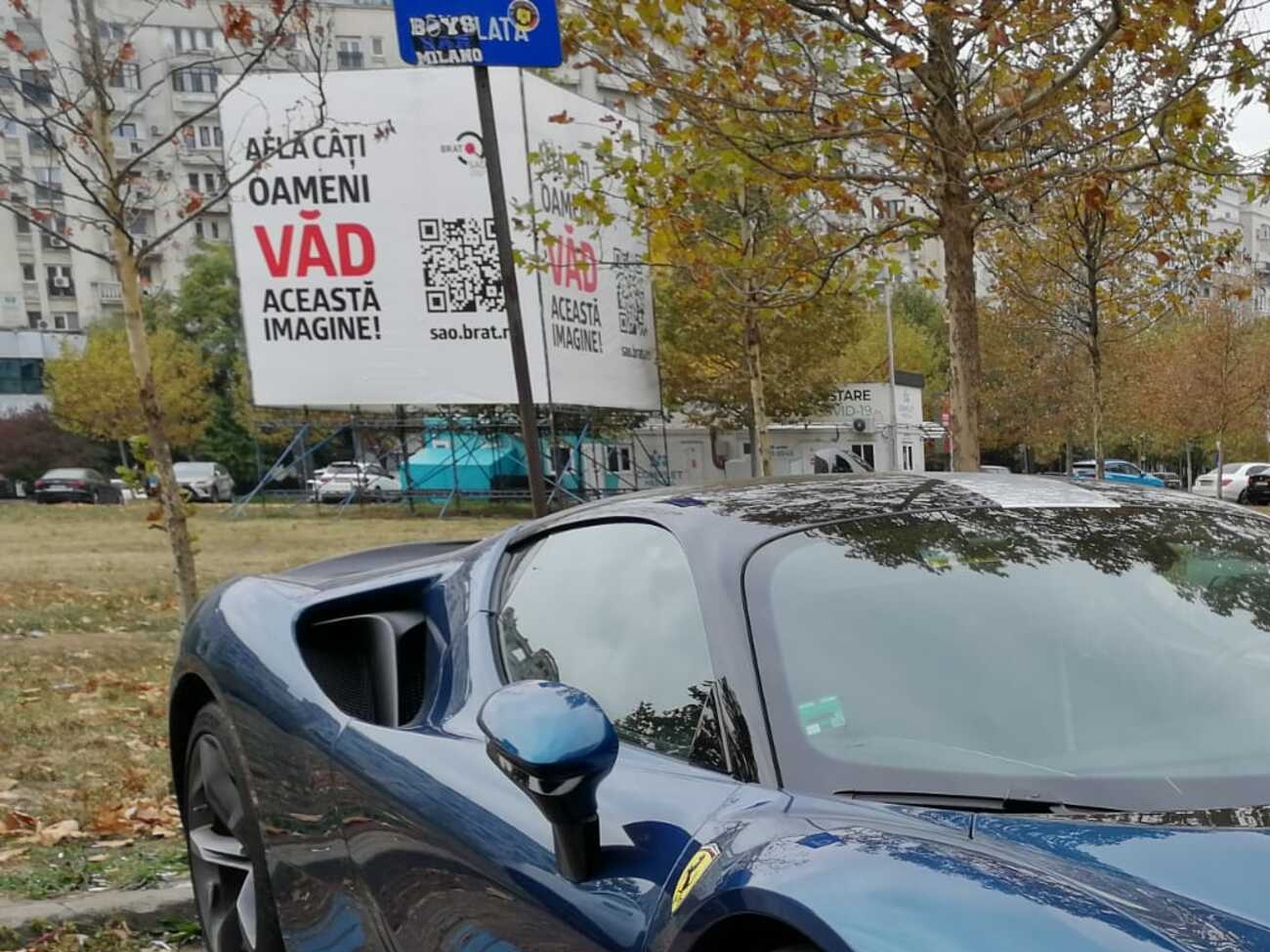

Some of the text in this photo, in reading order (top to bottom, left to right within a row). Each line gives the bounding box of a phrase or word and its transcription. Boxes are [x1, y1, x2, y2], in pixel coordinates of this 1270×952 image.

[474, 16, 529, 42] LATA
[416, 47, 483, 66] MILANO
[248, 174, 371, 206] OAMENI
[253, 209, 376, 277] VĂD
[547, 223, 598, 293] VĂD
[263, 281, 381, 313] ACEASTĂ
[551, 294, 602, 327] ACEASTĂ
[264, 316, 381, 341] IMAGINE!
[430, 323, 510, 340] sao.brat.r
[552, 324, 603, 354] IMAGINE!
[829, 389, 872, 401] STARE
